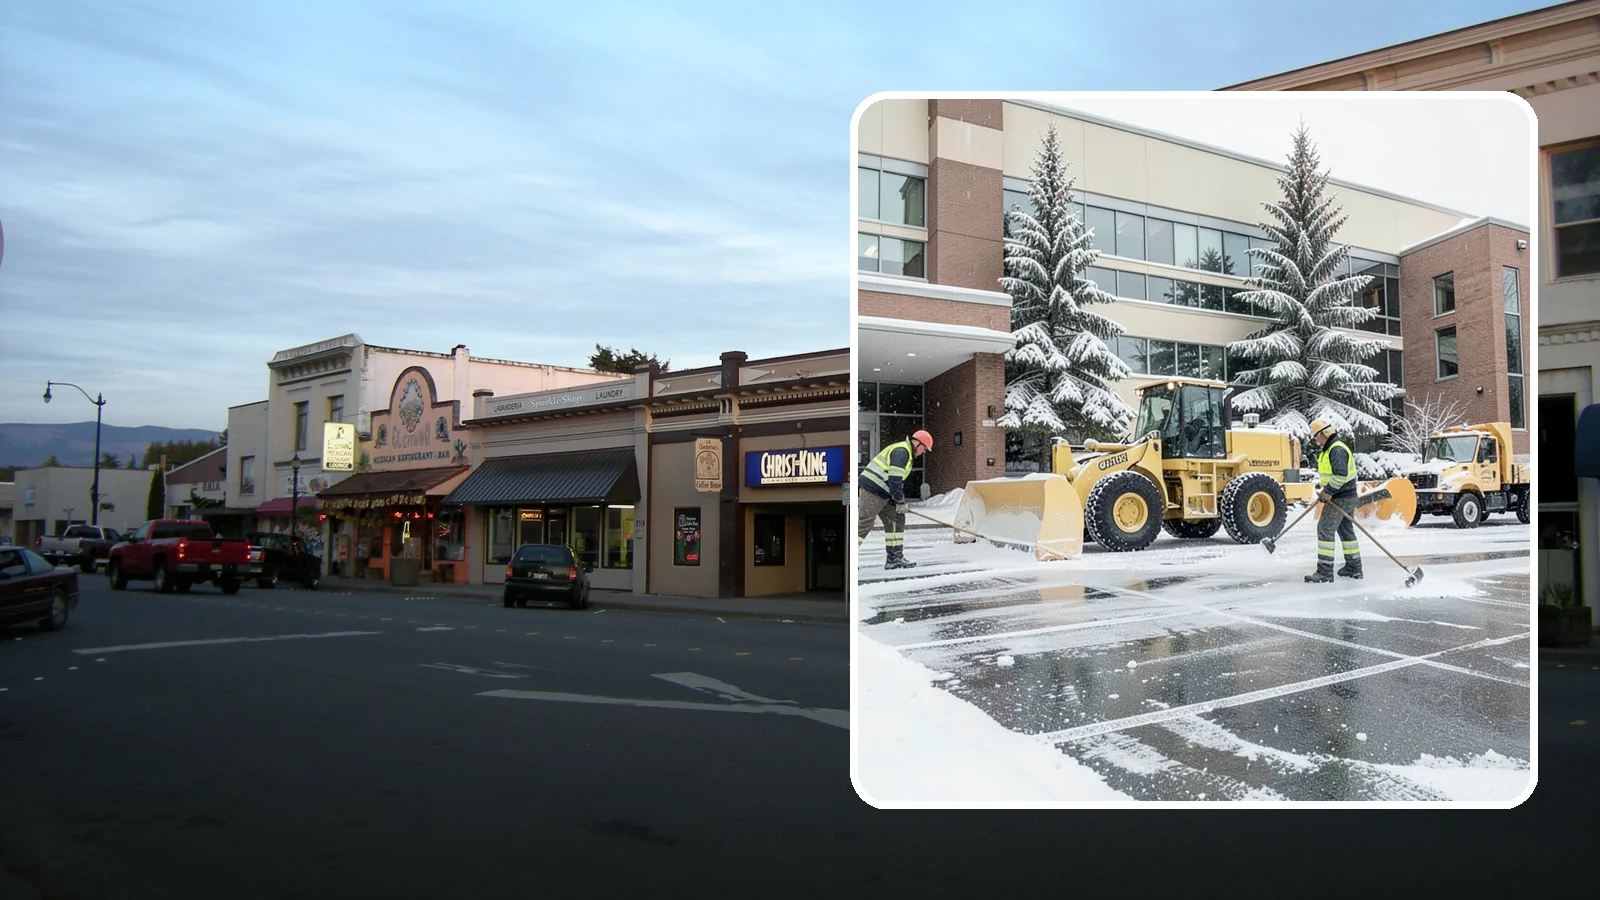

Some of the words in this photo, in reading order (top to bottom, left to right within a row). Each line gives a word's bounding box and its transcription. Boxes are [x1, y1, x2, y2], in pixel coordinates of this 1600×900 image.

[595, 389, 623, 400] LAUNDRY
[493, 402, 522, 413] LAVANDERIA
[530, 399, 560, 410] Sparkle
[561, 394, 583, 404] Shop
[373, 454, 396, 464] MEXICAN
[397, 451, 433, 462] RESTAURANT
[438, 450, 450, 459] BAR
[760, 452, 797, 478] CHRIST
[799, 449, 827, 476] KING
